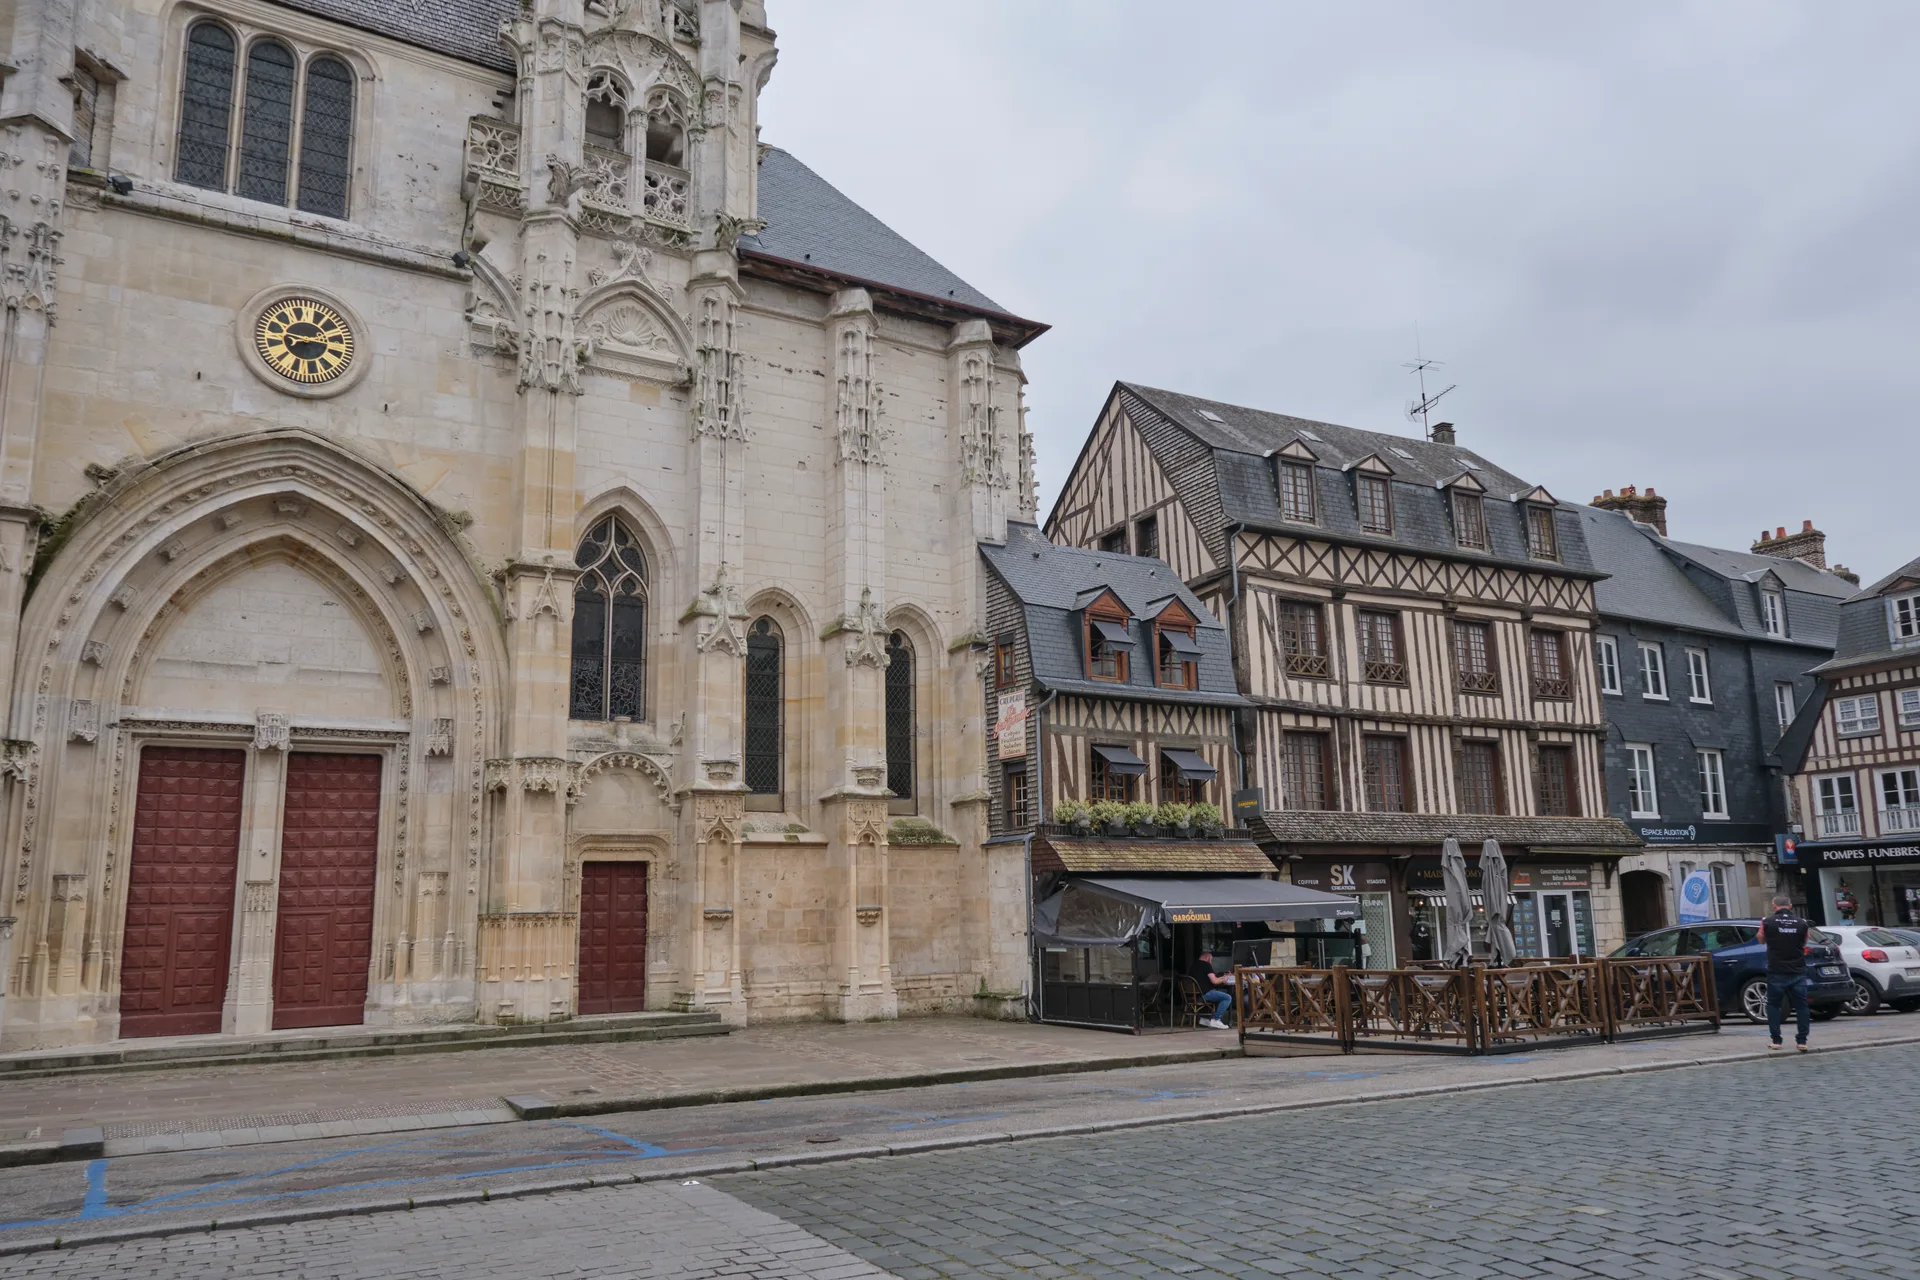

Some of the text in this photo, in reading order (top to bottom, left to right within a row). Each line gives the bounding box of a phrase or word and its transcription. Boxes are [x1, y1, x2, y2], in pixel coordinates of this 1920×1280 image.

[1664, 828, 1690, 836] AUDITION
[1823, 846, 1920, 860] POMPES FUNEBRES
[1330, 864, 1355, 886] SK
[1172, 913, 1211, 922] GARGOUILLE
